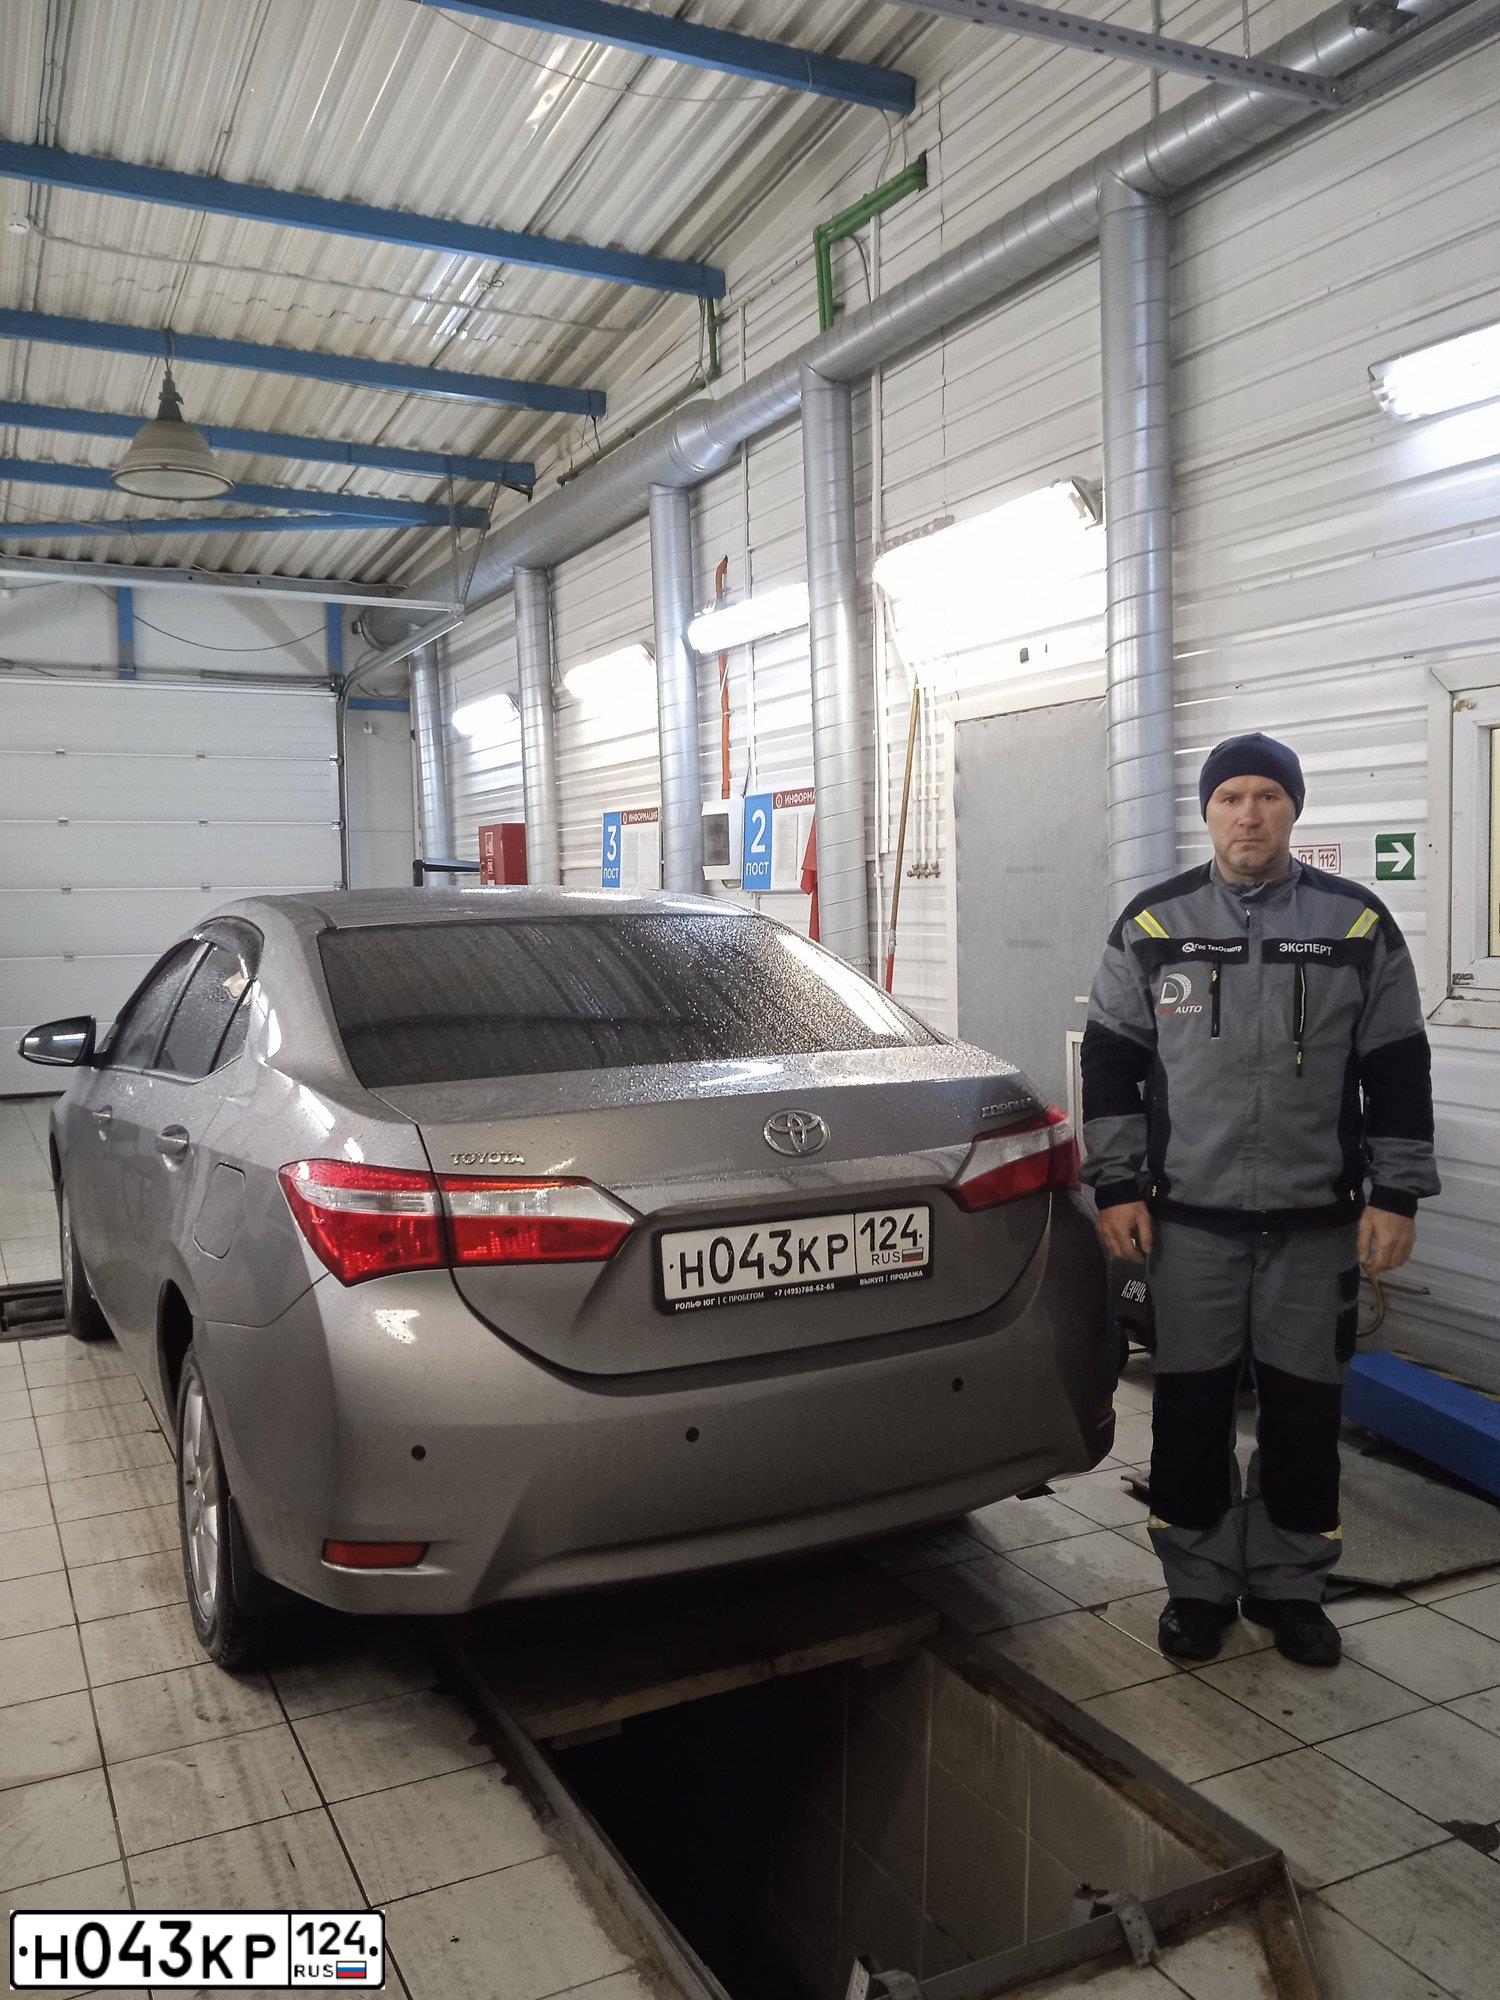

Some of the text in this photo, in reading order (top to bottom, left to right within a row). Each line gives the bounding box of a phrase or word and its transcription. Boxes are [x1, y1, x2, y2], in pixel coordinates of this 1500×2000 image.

[628, 810, 658, 822] ИНФОРМАЦИЯ
[750, 809, 766, 854] 2
[606, 825, 617, 861] 3
[1319, 853, 1336, 868] 112
[603, 867, 620, 879] ПОСТ
[745, 861, 770, 876] ПОСТ
[1279, 942, 1333, 956] ЭКСПЕРТ
[1174, 1005, 1203, 1014] AUTO
[450, 1151, 526, 1165] TOYOTA
[859, 1213, 919, 1252] 124
[871, 1250, 901, 1266] RUS
[675, 1300, 702, 1311] РОЛЬФ
[703, 1297, 716, 1307] ЮГ
[728, 1291, 765, 1303] ПРОБЕГОМ
[859, 1275, 884, 1286] ВЫКУП
[890, 1269, 924, 1281] ПРОДАЖА
